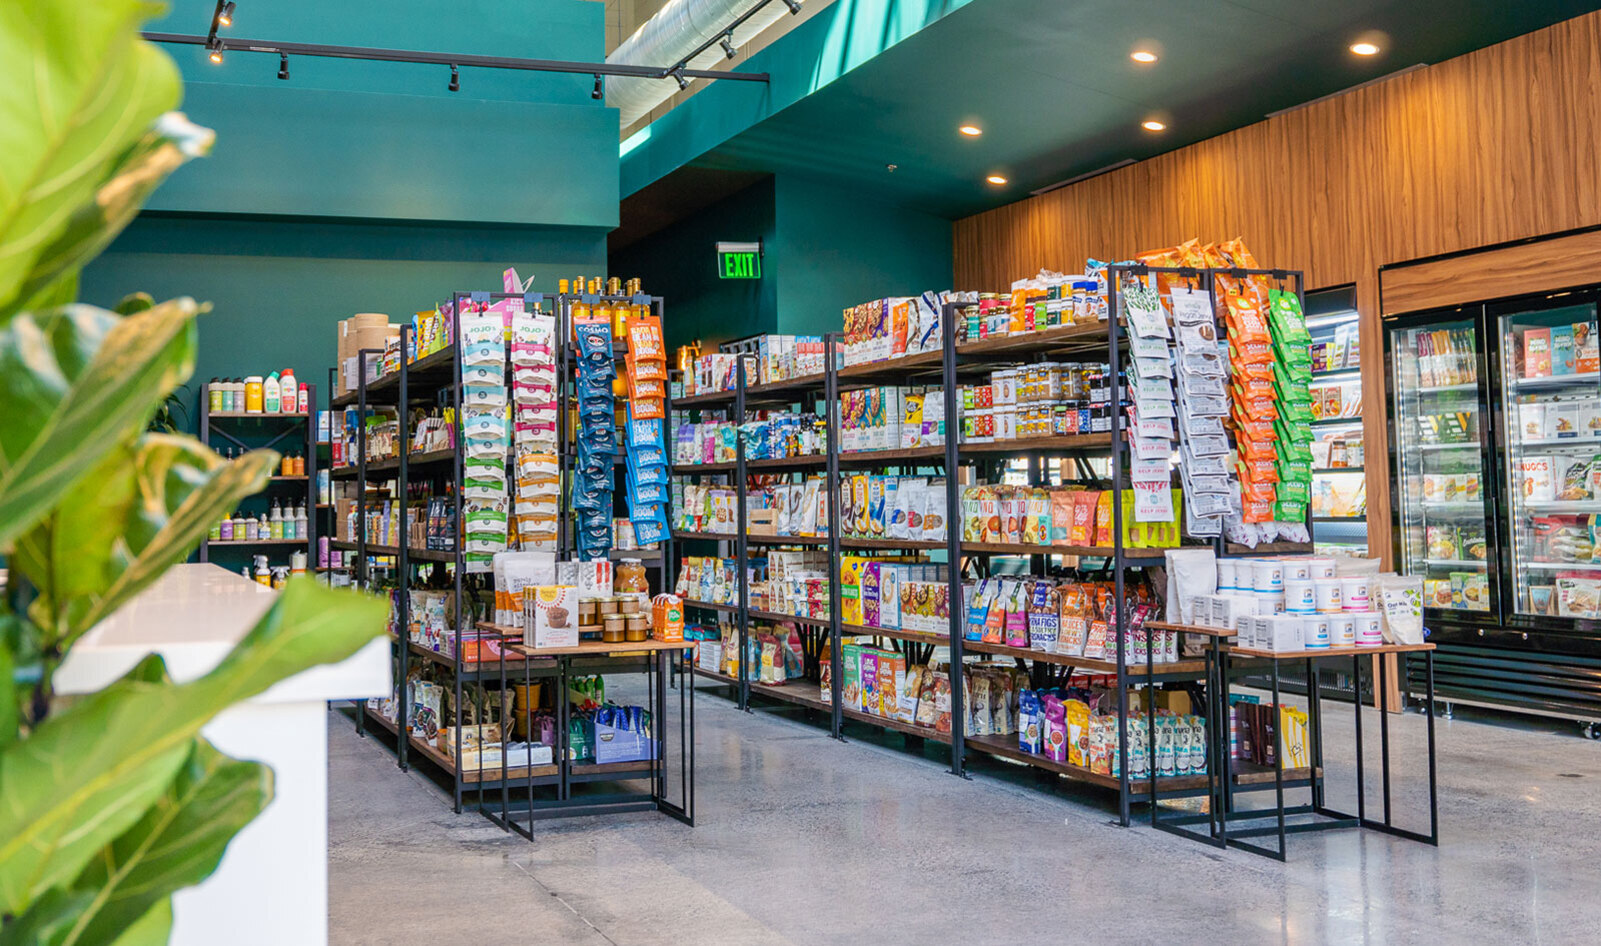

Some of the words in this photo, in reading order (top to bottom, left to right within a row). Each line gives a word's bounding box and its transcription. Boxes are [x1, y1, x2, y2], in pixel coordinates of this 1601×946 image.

[725, 253, 754, 277] EXIT
[578, 326, 608, 334] COSMO
[1041, 618, 1057, 627] FIGS
